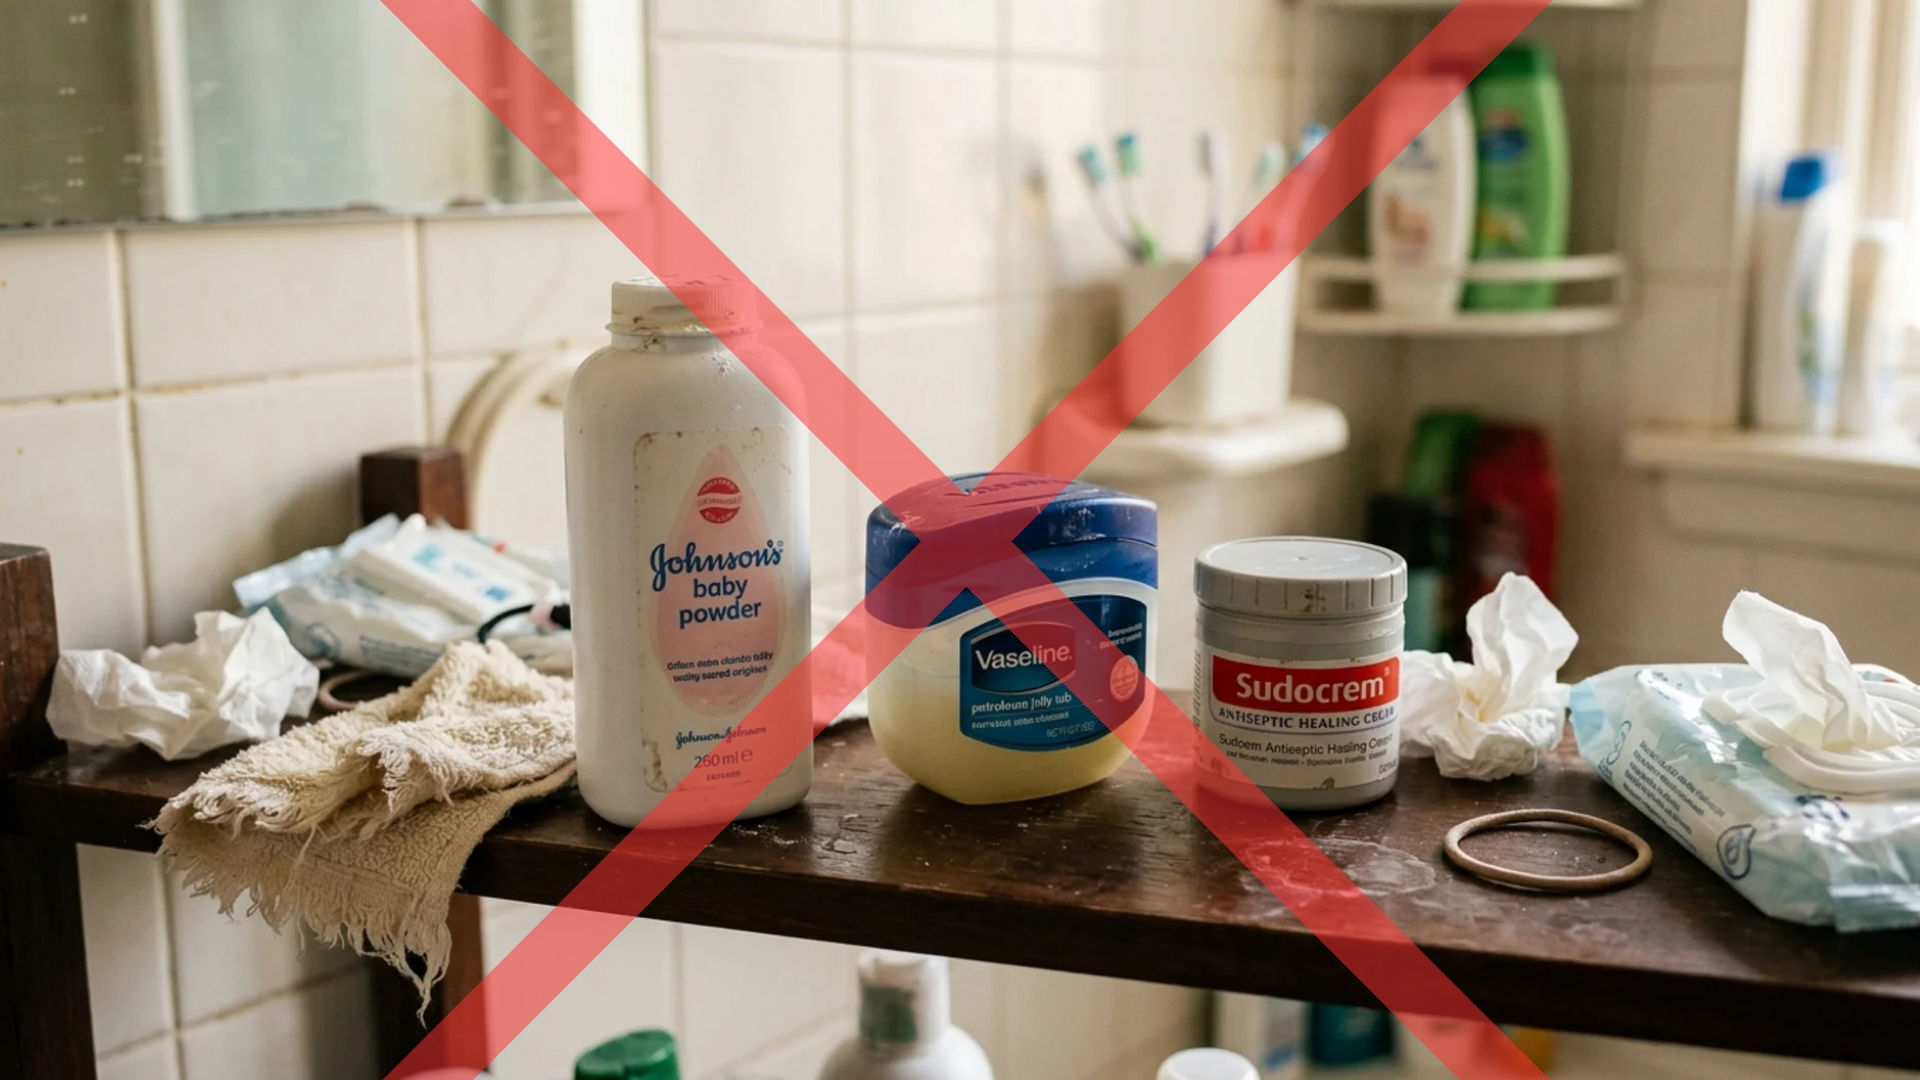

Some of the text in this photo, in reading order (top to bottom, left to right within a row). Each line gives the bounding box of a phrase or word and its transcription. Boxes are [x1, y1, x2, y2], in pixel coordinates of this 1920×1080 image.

[693, 576, 748, 600] baby
[679, 602, 762, 629] powder
[1236, 671, 1384, 704] Sudocrem
[1219, 707, 1294, 729] ANTISEPTIC
[1299, 716, 1360, 729] HEALING
[722, 751, 739, 765] ml
